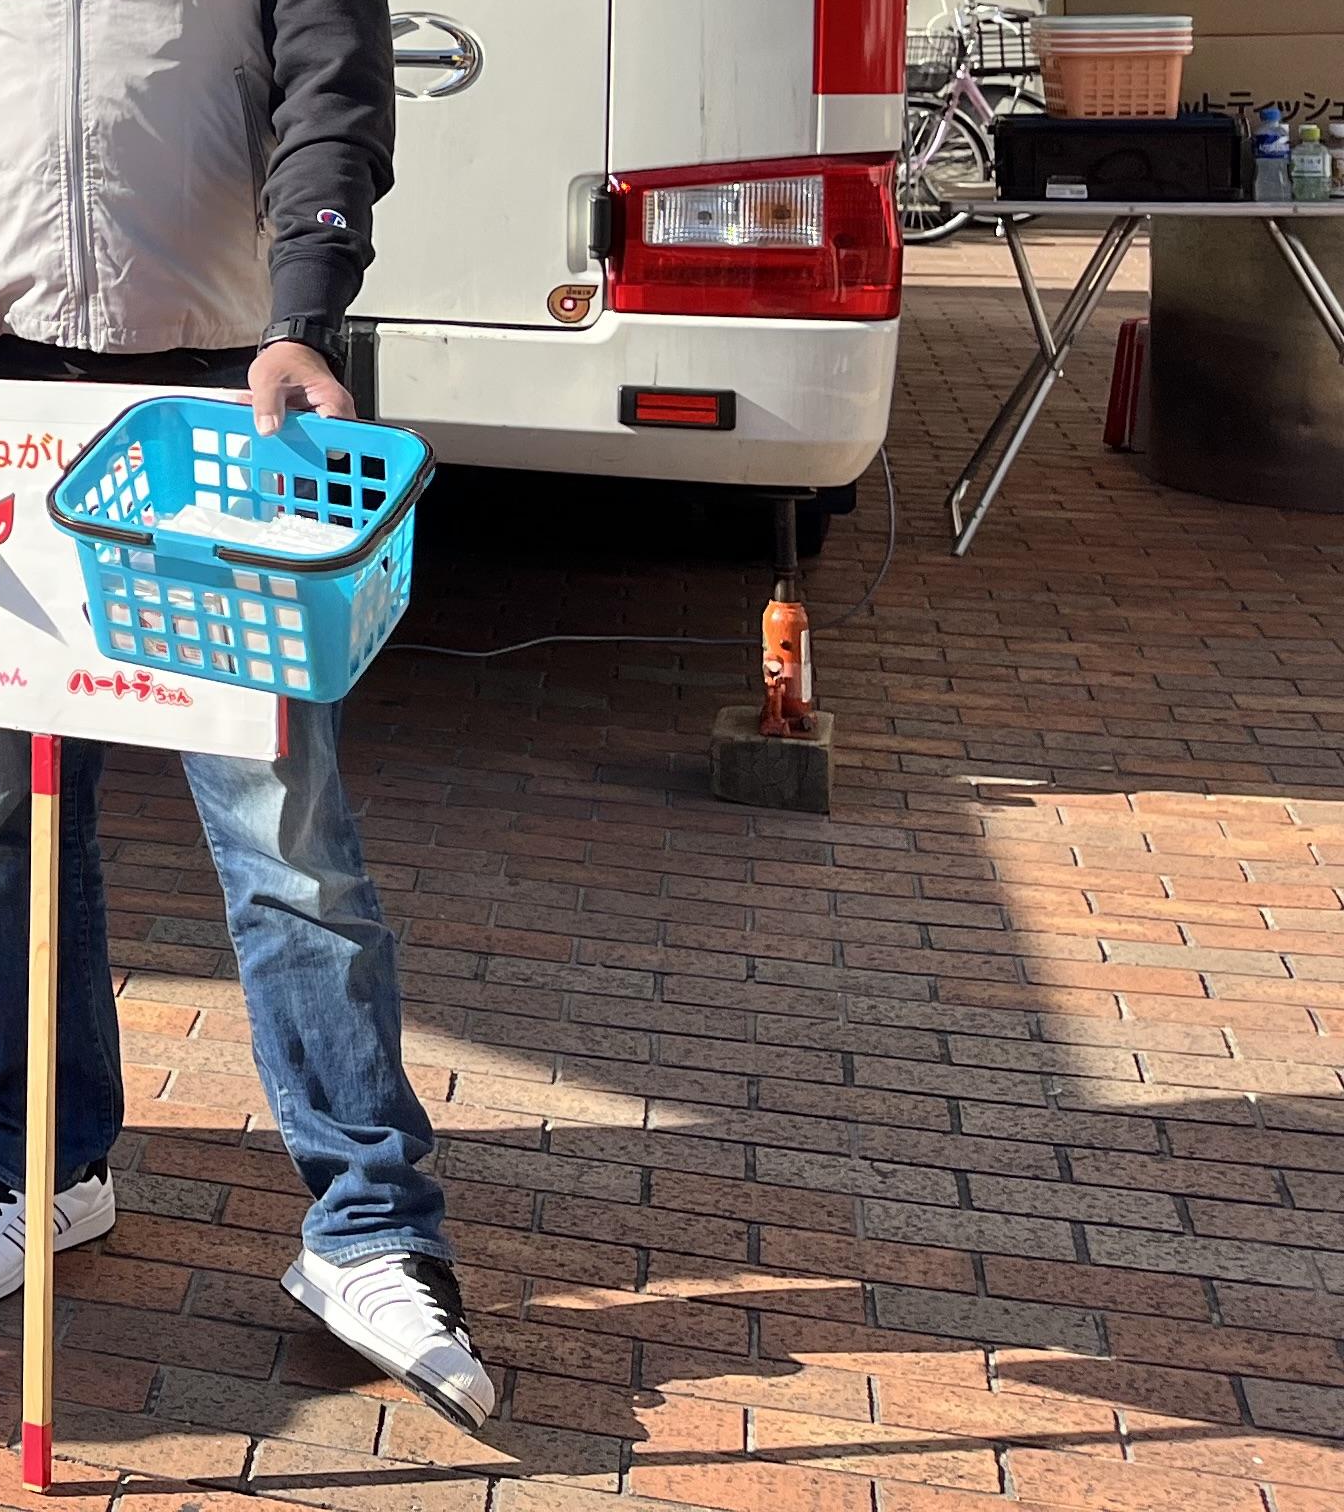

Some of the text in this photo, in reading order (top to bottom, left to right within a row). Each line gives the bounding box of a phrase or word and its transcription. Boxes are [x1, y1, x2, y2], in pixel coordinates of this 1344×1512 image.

[66, 668, 194, 708] ハートラちゃん
